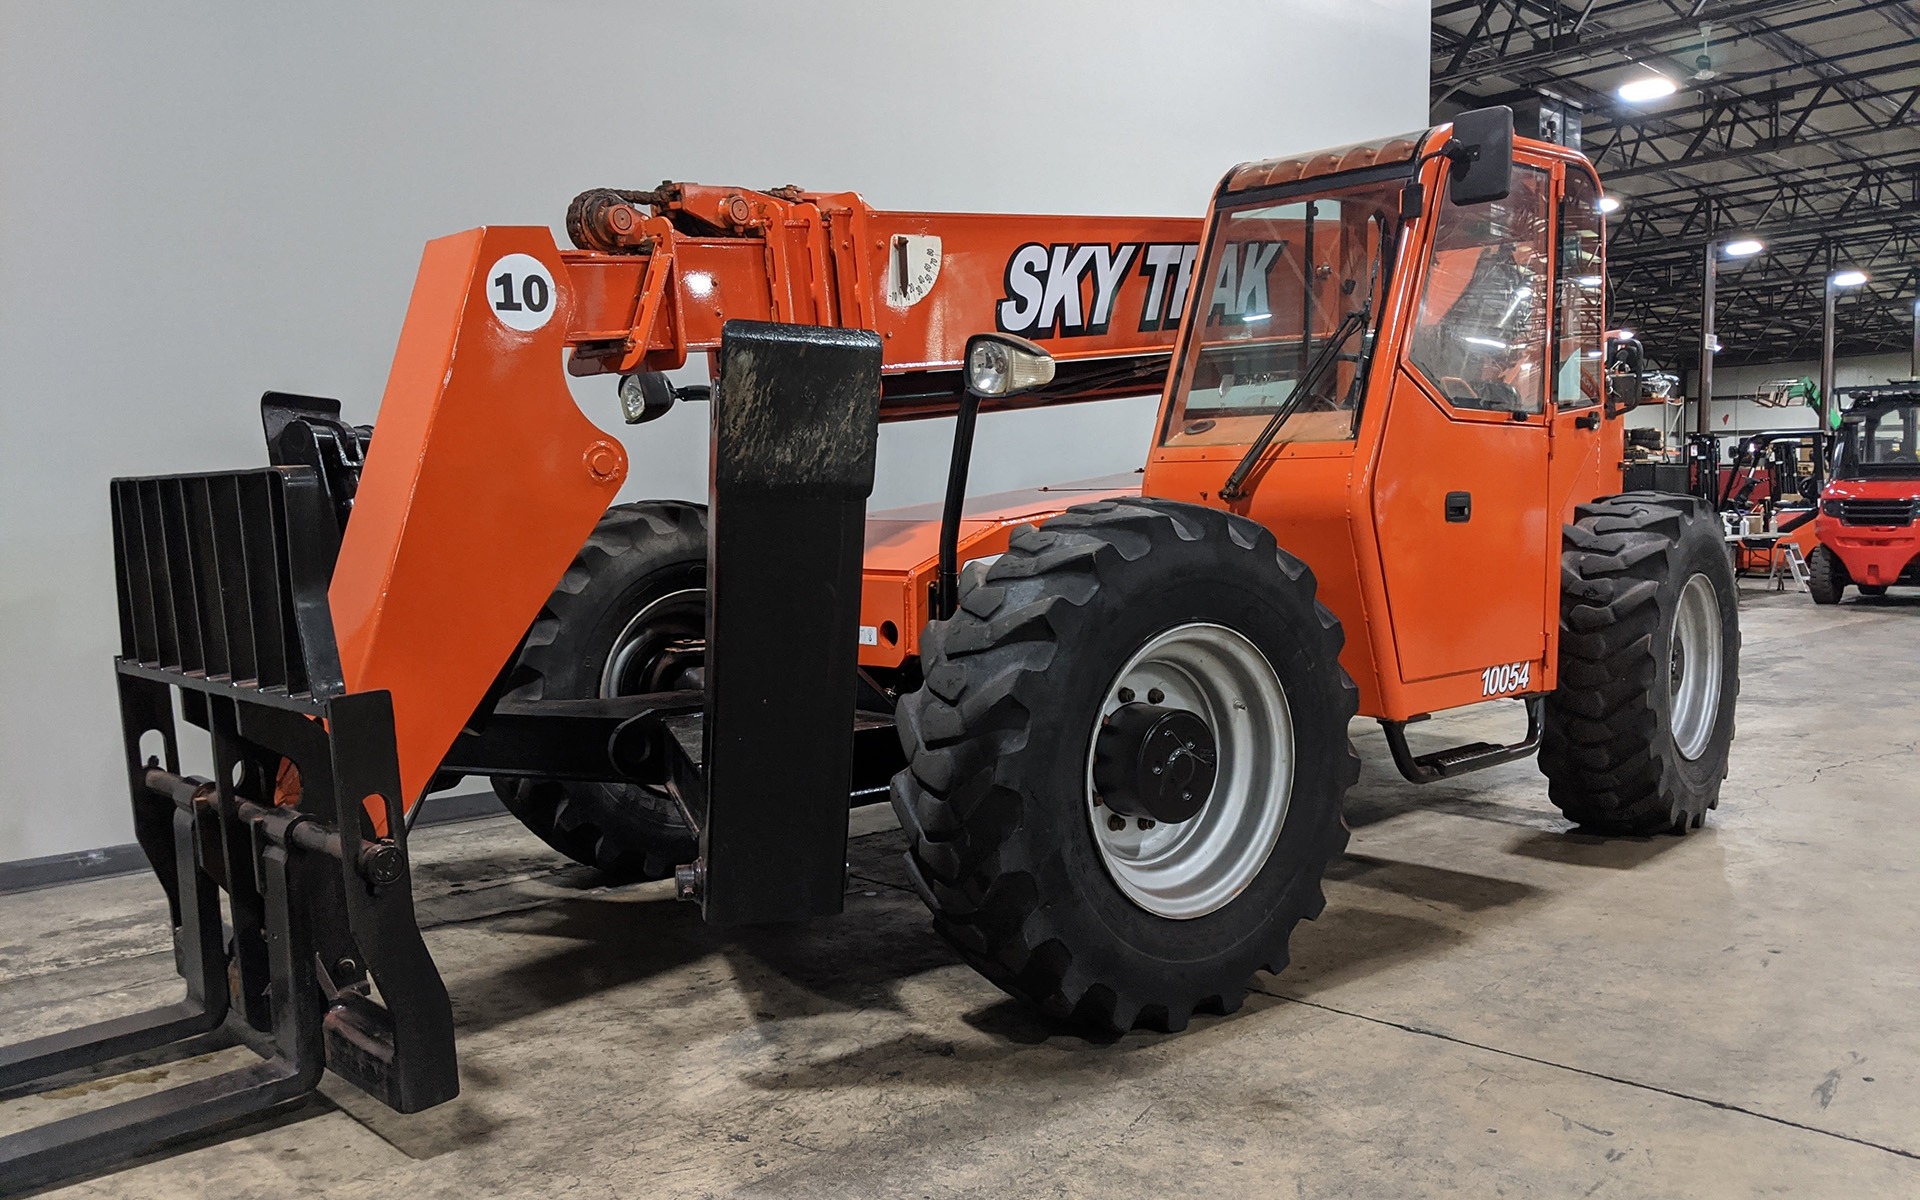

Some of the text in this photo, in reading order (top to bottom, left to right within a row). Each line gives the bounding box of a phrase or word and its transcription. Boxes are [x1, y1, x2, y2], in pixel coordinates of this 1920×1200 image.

[494, 272, 549, 313] 10
[1000, 243, 1140, 333] SKY
[1481, 661, 1531, 697] 10054
